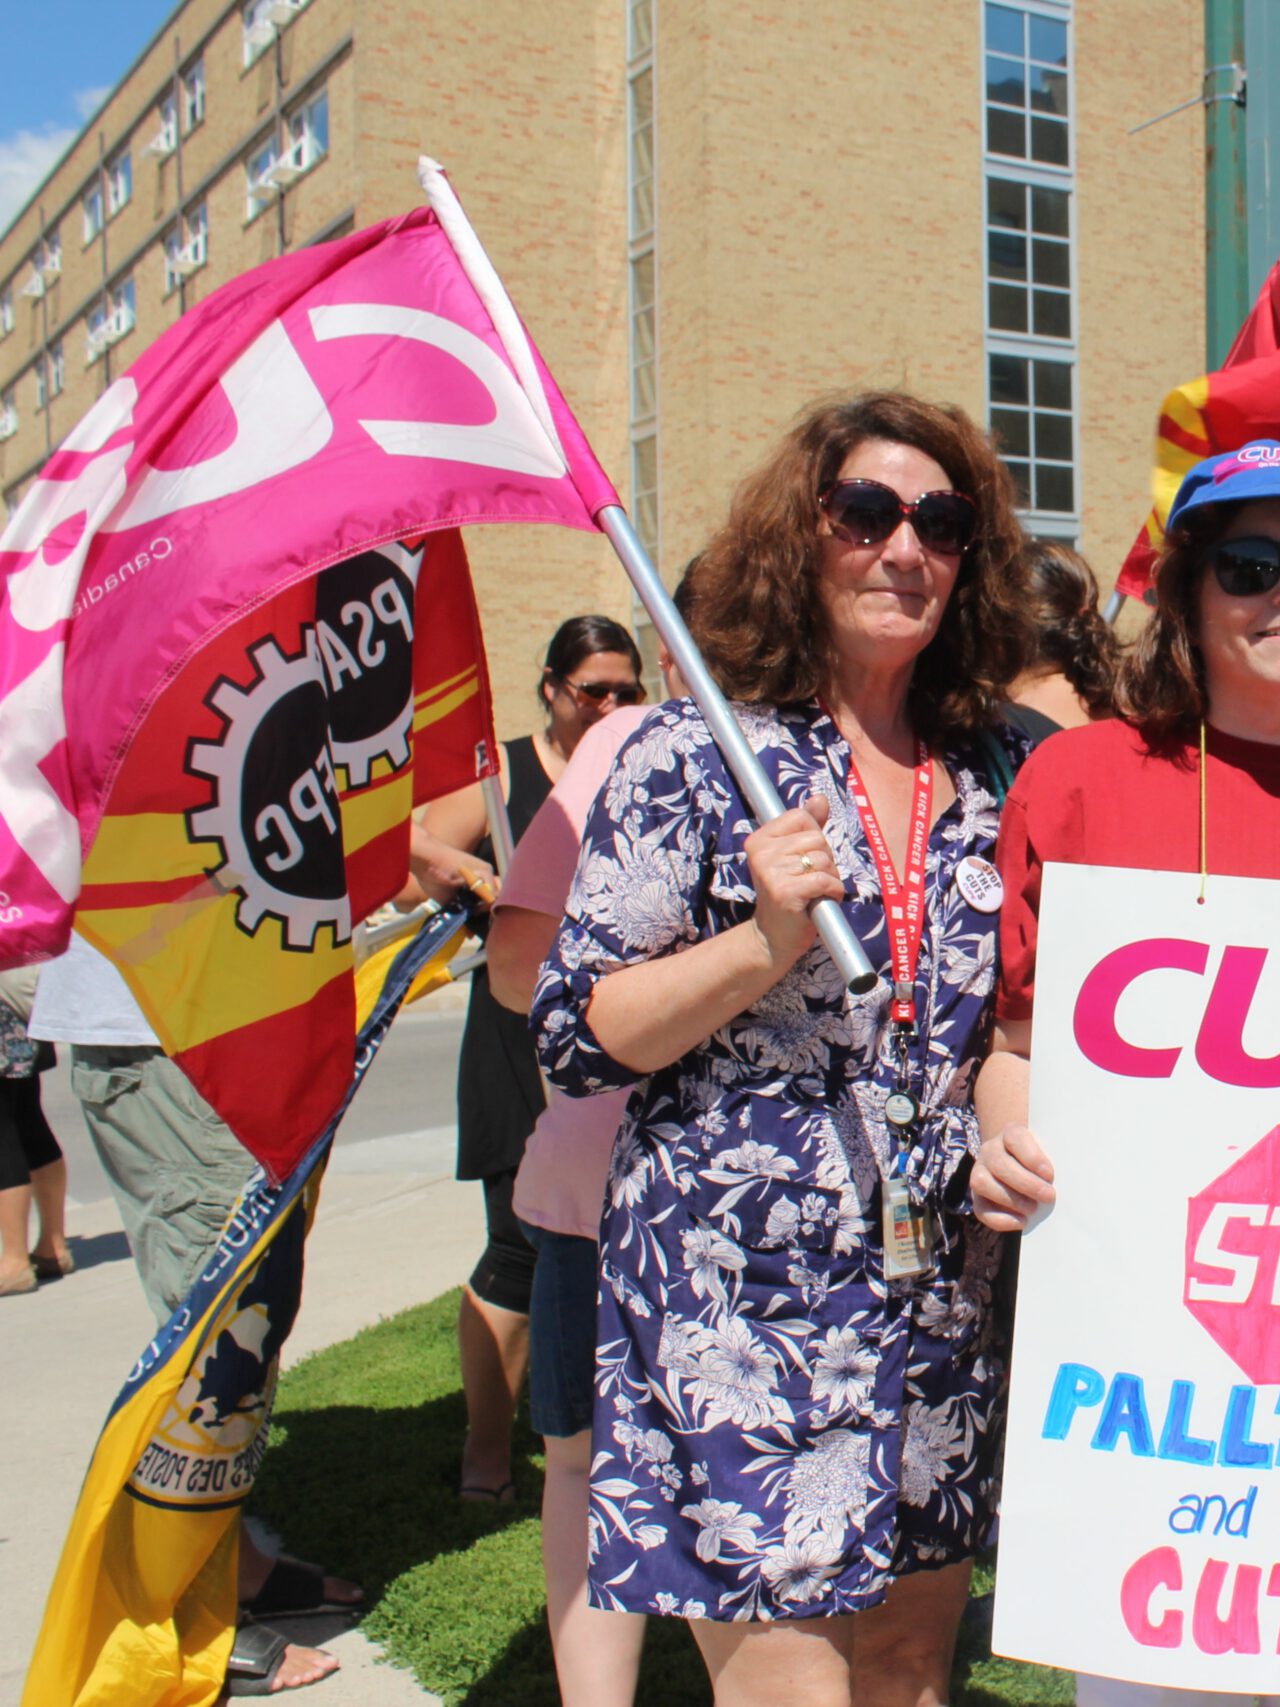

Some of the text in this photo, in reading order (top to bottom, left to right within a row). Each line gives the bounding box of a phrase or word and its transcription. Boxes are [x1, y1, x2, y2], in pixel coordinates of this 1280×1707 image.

[910, 790, 929, 866] KICK CANCER
[864, 814, 898, 895] KICK CANCER
[966, 873, 986, 901] CUTS
[977, 872, 992, 892] THE
[983, 864, 1002, 889] STOP
[906, 891, 919, 921] KICK
[895, 928, 910, 982] CANCER
[1168, 1485, 1258, 1539] and
